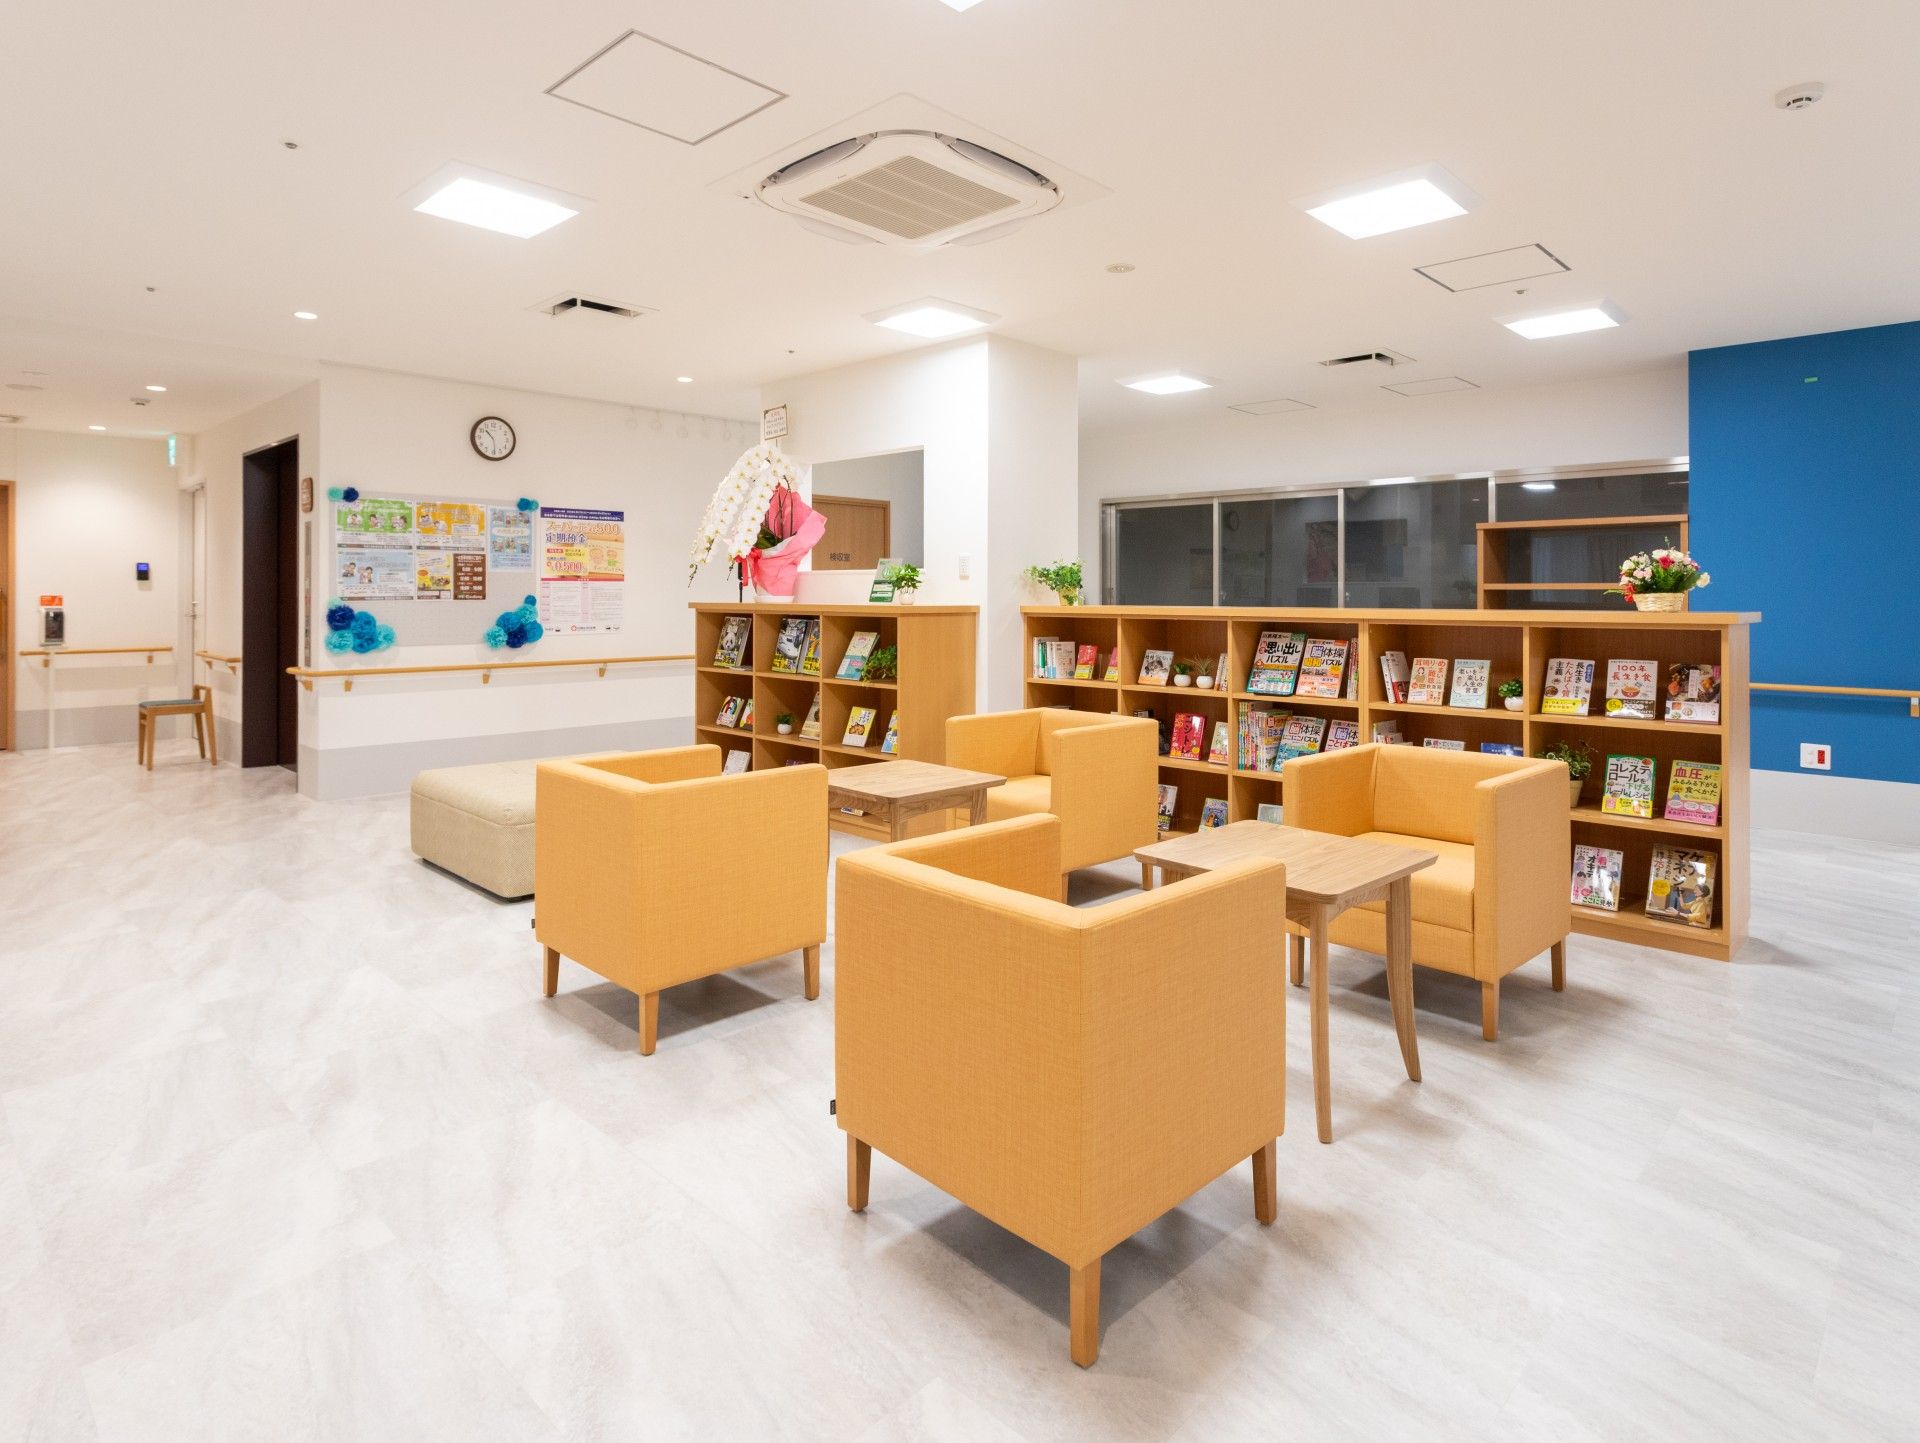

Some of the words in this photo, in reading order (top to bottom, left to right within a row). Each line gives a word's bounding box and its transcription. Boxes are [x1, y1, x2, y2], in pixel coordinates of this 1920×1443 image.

[1266, 641, 1301, 656] 思い出し
[1266, 655, 1289, 664] パズル
[1617, 664, 1648, 672] 100年
[1607, 763, 1650, 775] コレステ
[1674, 767, 1712, 780] 血圧が
[1607, 772, 1645, 784] ロールを
[1673, 778, 1718, 789] みるみる下がる
[1685, 786, 1718, 797] 食べかた
